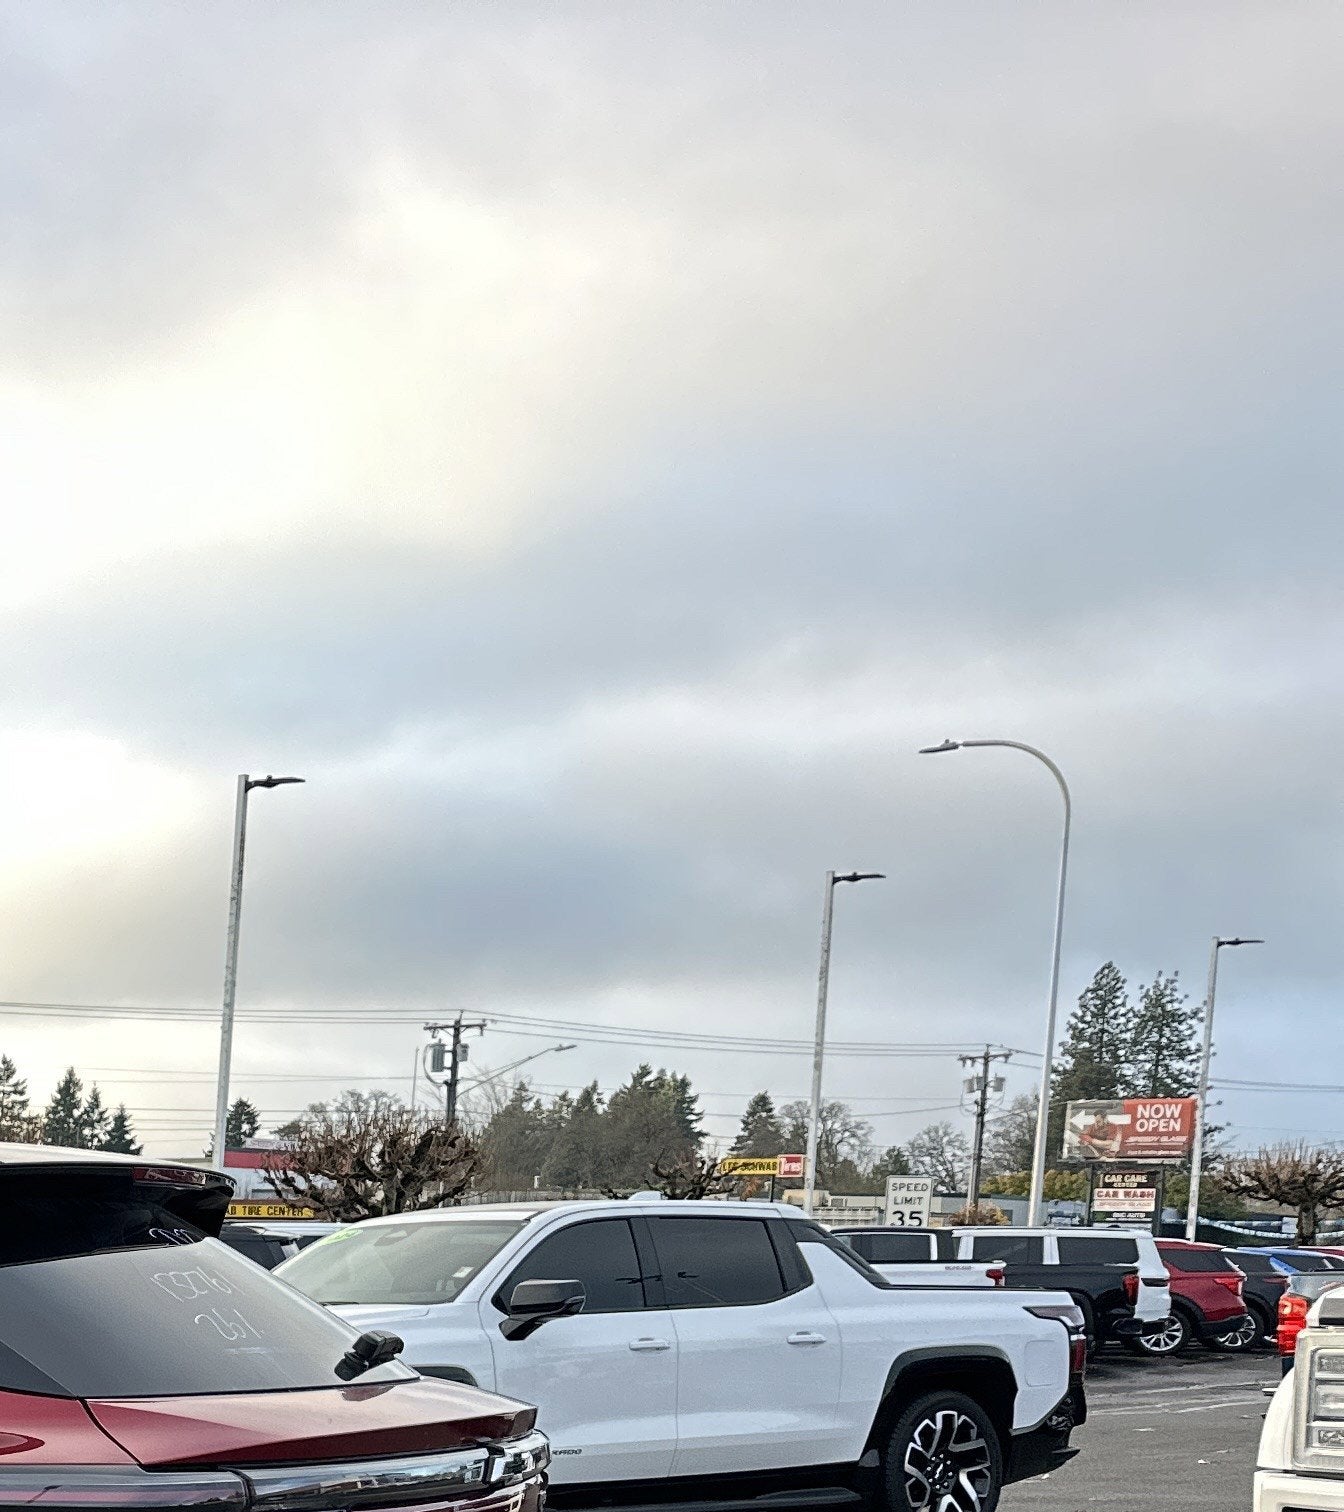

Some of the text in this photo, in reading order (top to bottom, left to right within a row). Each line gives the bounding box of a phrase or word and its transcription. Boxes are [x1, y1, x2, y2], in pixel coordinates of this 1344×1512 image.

[1136, 1103, 1183, 1119] NOW
[1135, 1118, 1182, 1133] OPEN
[1104, 1174, 1148, 1183] CAR CARE
[892, 1182, 929, 1191] SPEED
[1096, 1190, 1155, 1198] CAR WASH
[893, 1196, 924, 1205] LIMIT
[242, 1205, 261, 1215] TIRE
[266, 1205, 304, 1217] CENTER
[890, 1210, 922, 1227] 35
